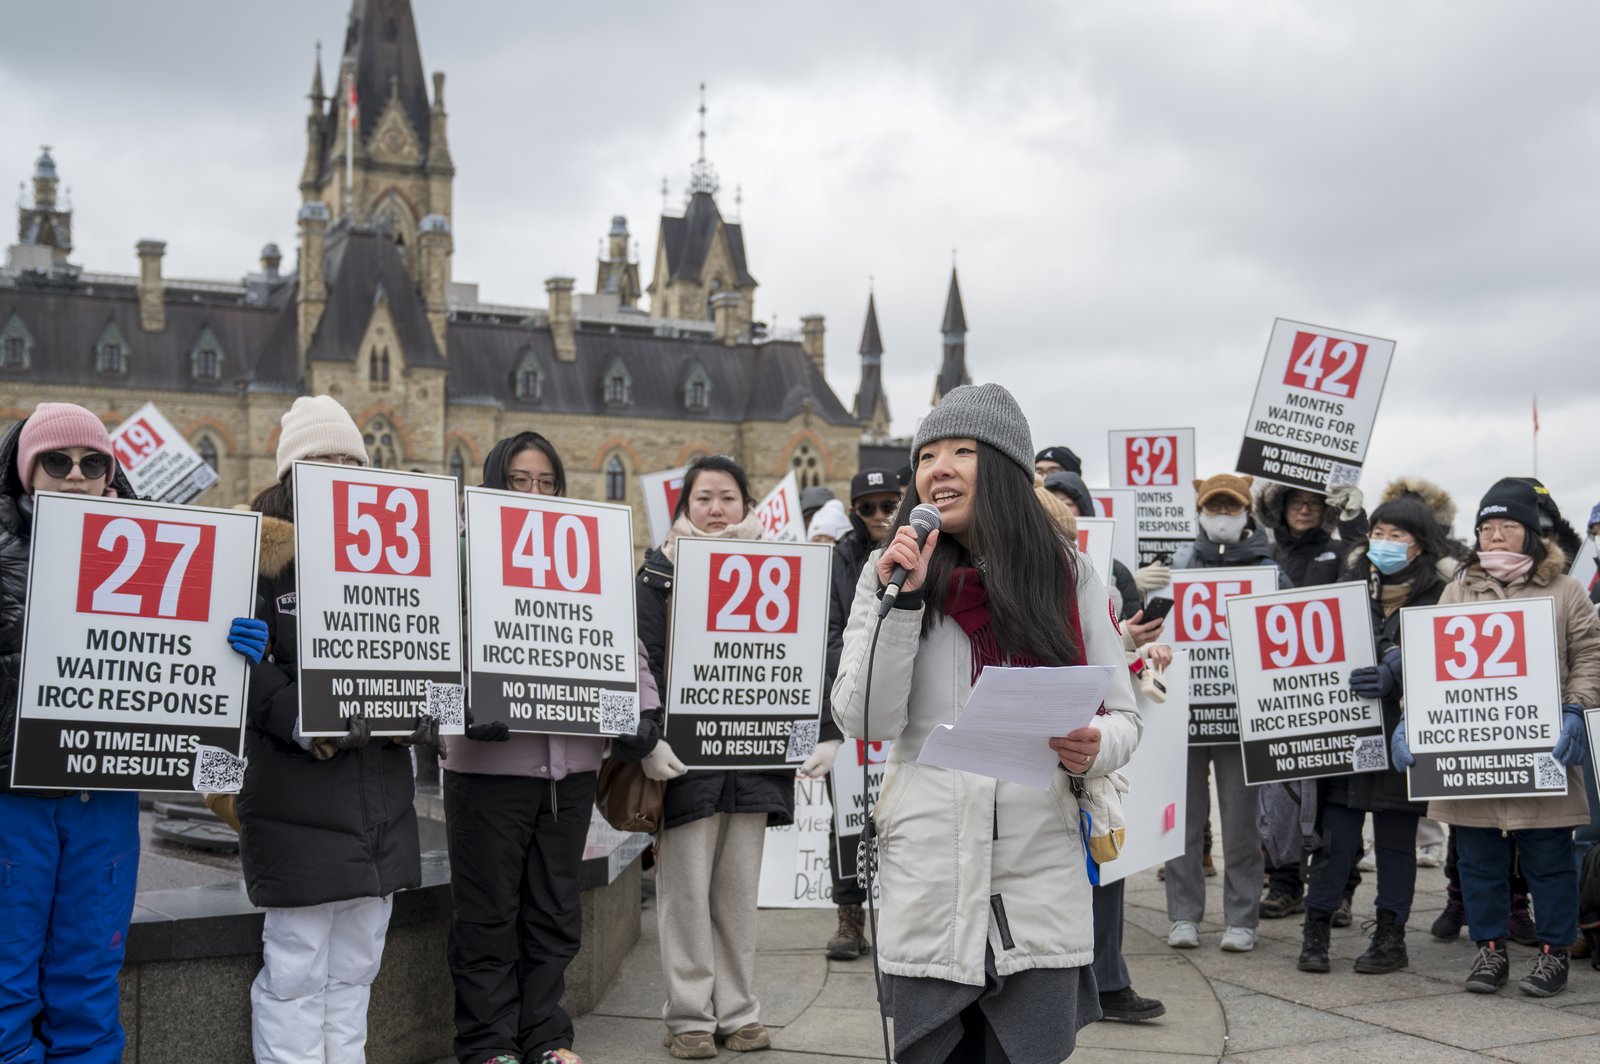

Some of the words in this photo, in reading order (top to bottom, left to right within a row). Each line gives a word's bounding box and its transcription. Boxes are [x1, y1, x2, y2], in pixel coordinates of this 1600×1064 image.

[1293, 335, 1357, 396] 42
[1286, 393, 1344, 416] MONTHS
[1267, 405, 1323, 429] WAITING
[1327, 419, 1355, 436] FOR
[115, 423, 157, 467] 19
[1255, 420, 1284, 437] IRCC
[1286, 427, 1359, 454] RESPONSE
[1131, 437, 1173, 485] 32
[1261, 445, 1278, 459] NO
[1280, 448, 1332, 470] TIMELINE
[1263, 459, 1280, 474] NO
[1137, 506, 1162, 518] ITING
[1165, 506, 1184, 518] FOR
[345, 484, 420, 575] 53
[1139, 521, 1191, 532] RESPONSE
[512, 510, 590, 591] 40
[91, 517, 201, 617] 27
[343, 584, 420, 607] MONTHS
[715, 554, 791, 633] 28
[515, 598, 593, 621] MONTHS
[1182, 581, 1241, 641] 65
[323, 611, 400, 633] WAITING
[406, 614, 440, 635] FOR
[494, 621, 573, 645] WAITING
[579, 627, 614, 648] FOR
[1265, 600, 1335, 667] 90
[86, 628, 192, 656] MONTHS
[312, 638, 353, 659] IRCC
[357, 639, 451, 661] RESPONSE
[713, 641, 786, 660] MONTHS
[1444, 612, 1518, 679] 32
[483, 644, 525, 664] IRCC
[528, 648, 625, 672] RESPONSE
[56, 656, 162, 684] WAITING
[169, 664, 217, 687] FOR
[693, 664, 766, 683] WAITING
[771, 666, 803, 683] FOR
[1190, 665, 1229, 679] ITING
[1273, 671, 1340, 692] MONTHS
[332, 678, 354, 696] NO
[502, 681, 526, 698] NO
[680, 687, 720, 705] IRCC
[722, 688, 811, 706] RESPONSE
[1193, 683, 1235, 697] RESP
[1445, 686, 1518, 704] MONTHS
[37, 684, 94, 710] IRCC
[98, 688, 229, 716] RESPONSE
[339, 700, 361, 719] NO
[364, 701, 427, 719] RESULTS
[1257, 692, 1324, 713] WAITING
[1329, 689, 1360, 705] FOR
[510, 702, 532, 719] NO
[537, 703, 600, 723] RESULTS
[1250, 717, 1285, 733] IRCC
[1288, 705, 1371, 728] RESPONSE
[1427, 706, 1499, 725] WAITING
[1505, 705, 1539, 720] FOR
[696, 720, 718, 737] NO
[720, 720, 793, 737] TIMELINES
[1200, 722, 1239, 736] RESUL
[1418, 729, 1455, 745] IRCC
[1459, 724, 1551, 743] RESPONSE
[59, 729, 91, 750] NO
[94, 730, 201, 754] TIMELINES
[701, 740, 722, 755] NO
[726, 739, 786, 755] RESULTS
[1269, 742, 1288, 757] NO
[1289, 734, 1358, 754] TIMELINES
[66, 753, 99, 774] NO
[101, 755, 190, 777] RESULTS
[1276, 757, 1296, 772] NO
[1297, 752, 1353, 769] RESULTS
[1436, 757, 1456, 771] NO
[1458, 753, 1535, 770] TIMELINES
[1443, 773, 1464, 787] NO
[1467, 770, 1529, 786] RESULTS
